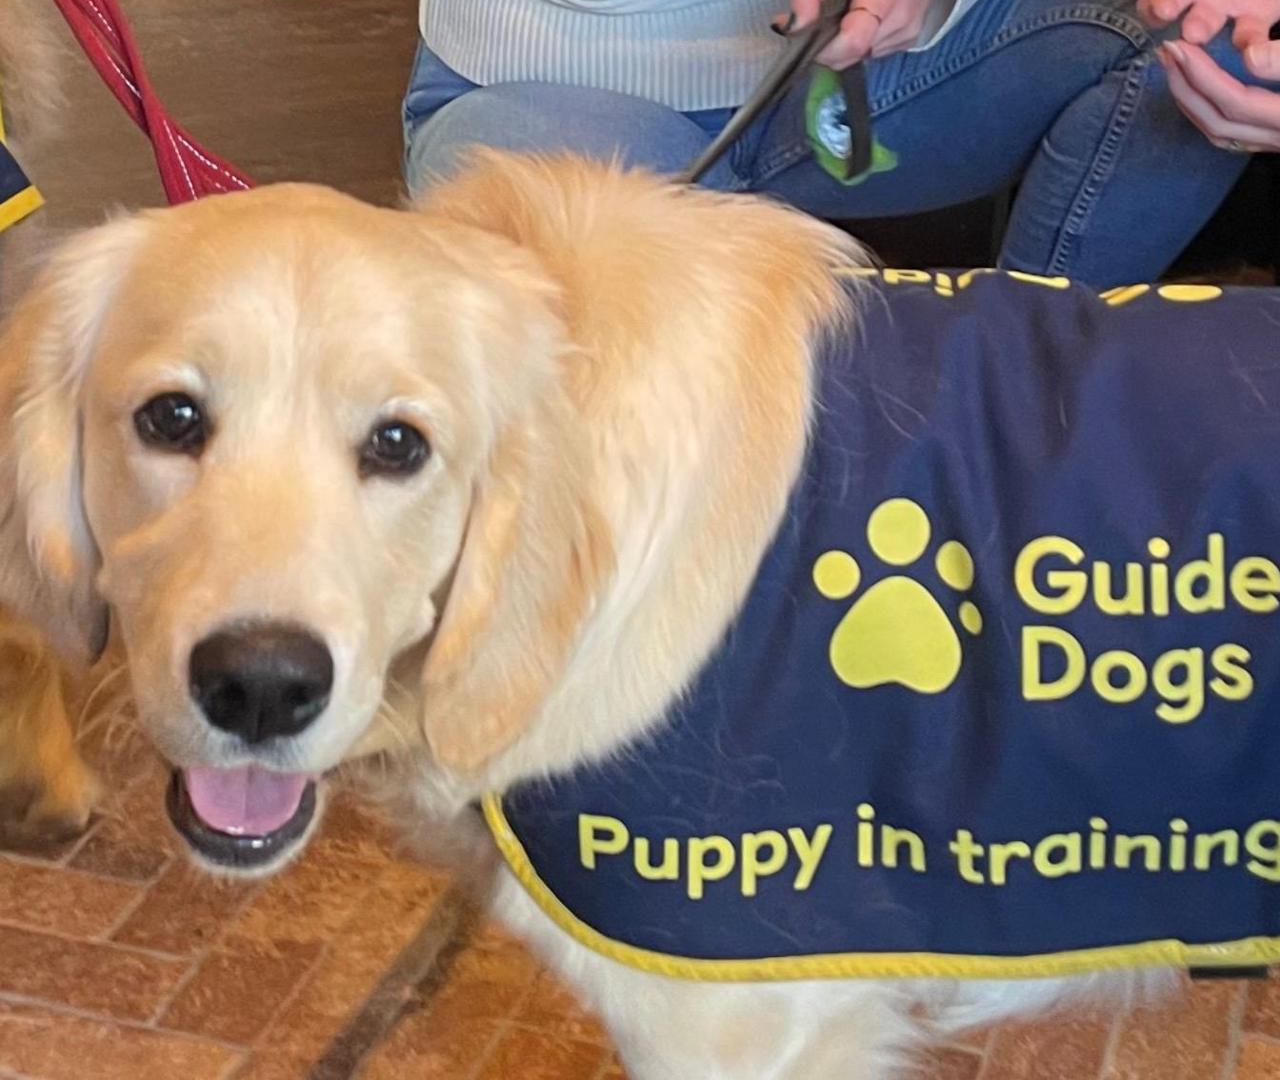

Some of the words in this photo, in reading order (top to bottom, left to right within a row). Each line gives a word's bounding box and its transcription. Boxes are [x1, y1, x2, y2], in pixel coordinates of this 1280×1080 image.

[1022, 625, 1254, 724] Dogs
[576, 813, 834, 898] Puppy
[856, 804, 926, 872] in
